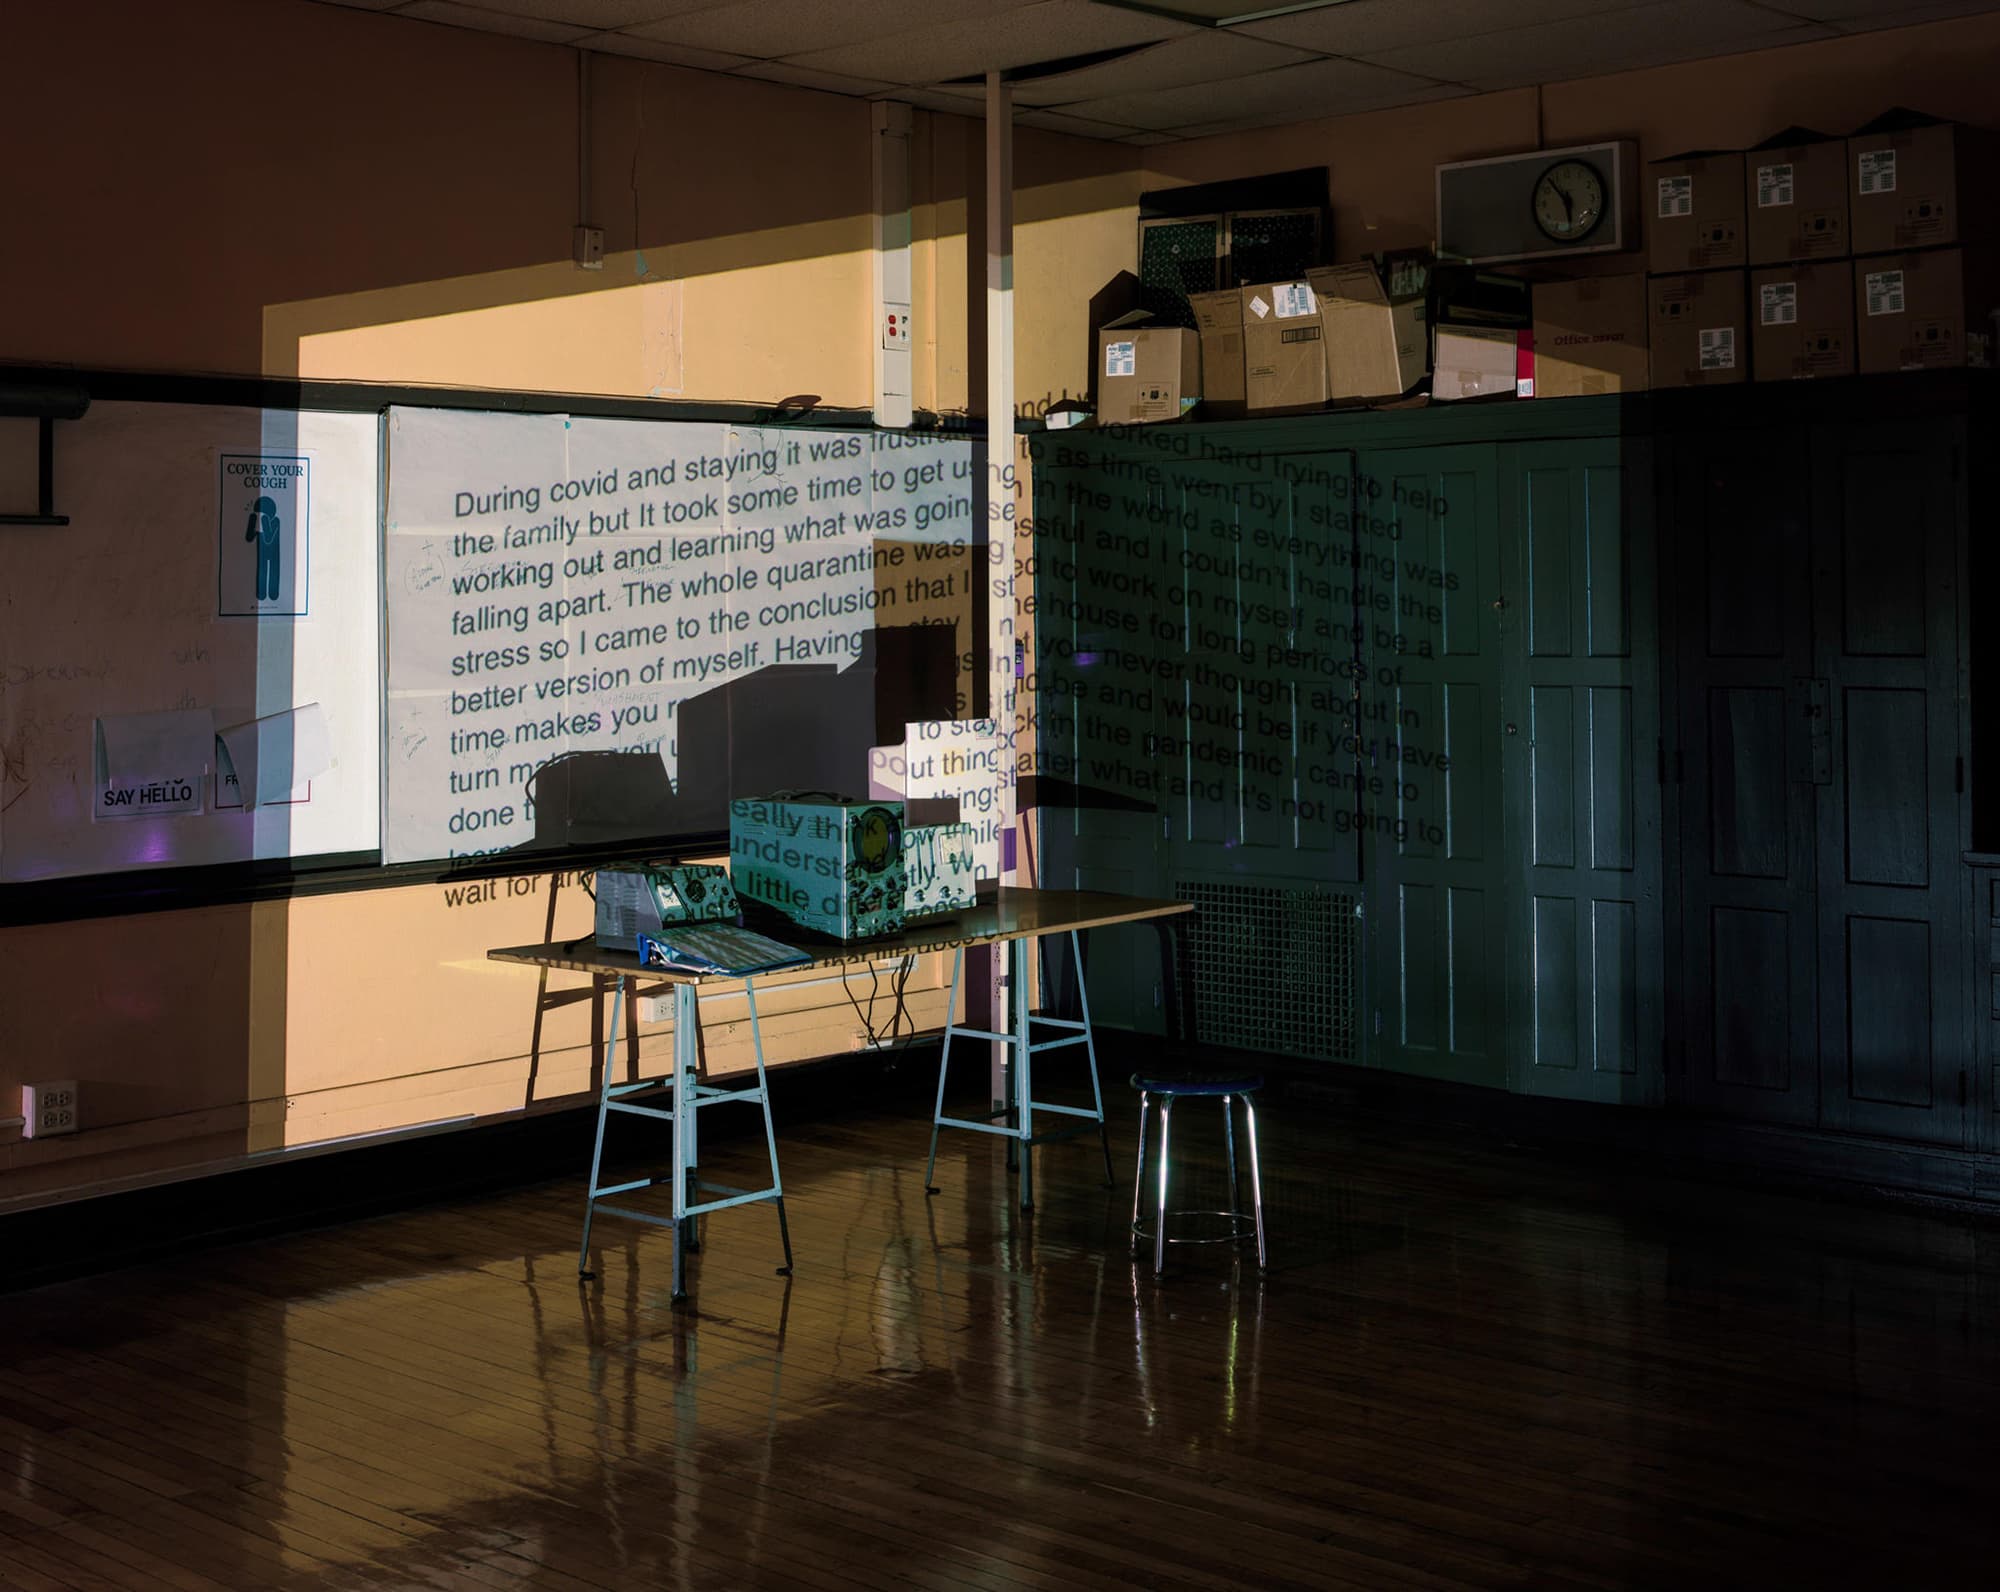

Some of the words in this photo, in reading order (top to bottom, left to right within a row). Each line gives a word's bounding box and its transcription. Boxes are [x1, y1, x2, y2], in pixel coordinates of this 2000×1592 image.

[227, 463, 268, 476] COVER
[271, 464, 304, 477] YOUR
[244, 476, 287, 489] COUGH
[455, 485, 541, 518] During
[550, 467, 619, 503] covid
[627, 459, 676, 491] and
[685, 448, 777, 483] staying
[786, 440, 801, 466] it
[809, 435, 862, 462] was
[1274, 454, 1349, 498] trying
[1393, 477, 1449, 522] help
[454, 532, 495, 558] the
[503, 515, 580, 549] family
[589, 507, 630, 537] but
[639, 503, 656, 528] It
[663, 493, 719, 524] took
[727, 485, 799, 514] some
[806, 476, 862, 502] time
[869, 469, 895, 492] to
[903, 459, 944, 494] get
[452, 561, 554, 596] working
[563, 549, 605, 578] out
[613, 540, 662, 571] and
[671, 526, 775, 561] learning
[784, 512, 846, 544] what
[853, 507, 907, 533] was
[915, 495, 973, 530] goin
[452, 604, 529, 636] falling
[537, 589, 612, 627] apart.
[622, 581, 672, 608] The
[681, 566, 758, 600] whole
[766, 544, 905, 592] quarantine
[914, 539, 966, 561] was
[1087, 566, 1157, 600] work
[1404, 560, 1460, 592] was
[451, 643, 530, 678] stress
[539, 638, 569, 662] so
[580, 630, 586, 655] I
[594, 623, 668, 653] came
[676, 617, 700, 640] to
[708, 608, 750, 634] the
[758, 586, 896, 627] conclusion
[905, 574, 954, 603] that
[964, 570, 969, 593] I
[1399, 593, 1443, 625] the
[451, 684, 528, 715] better
[535, 666, 631, 700] version
[639, 656, 665, 685] of
[673, 642, 764, 682] myself.
[775, 628, 865, 663] Having
[450, 728, 506, 755] time
[515, 711, 602, 745] makes
[610, 703, 659, 735] you
[918, 720, 941, 740] to
[104, 788, 136, 807] SAY
[140, 785, 193, 804] HELLO
[225, 774, 239, 786] FR
[450, 767, 500, 794] turn
[449, 805, 515, 834] done
[731, 799, 804, 838] eally
[444, 877, 497, 909] wait
[506, 873, 541, 898] for
[748, 870, 811, 908] little
